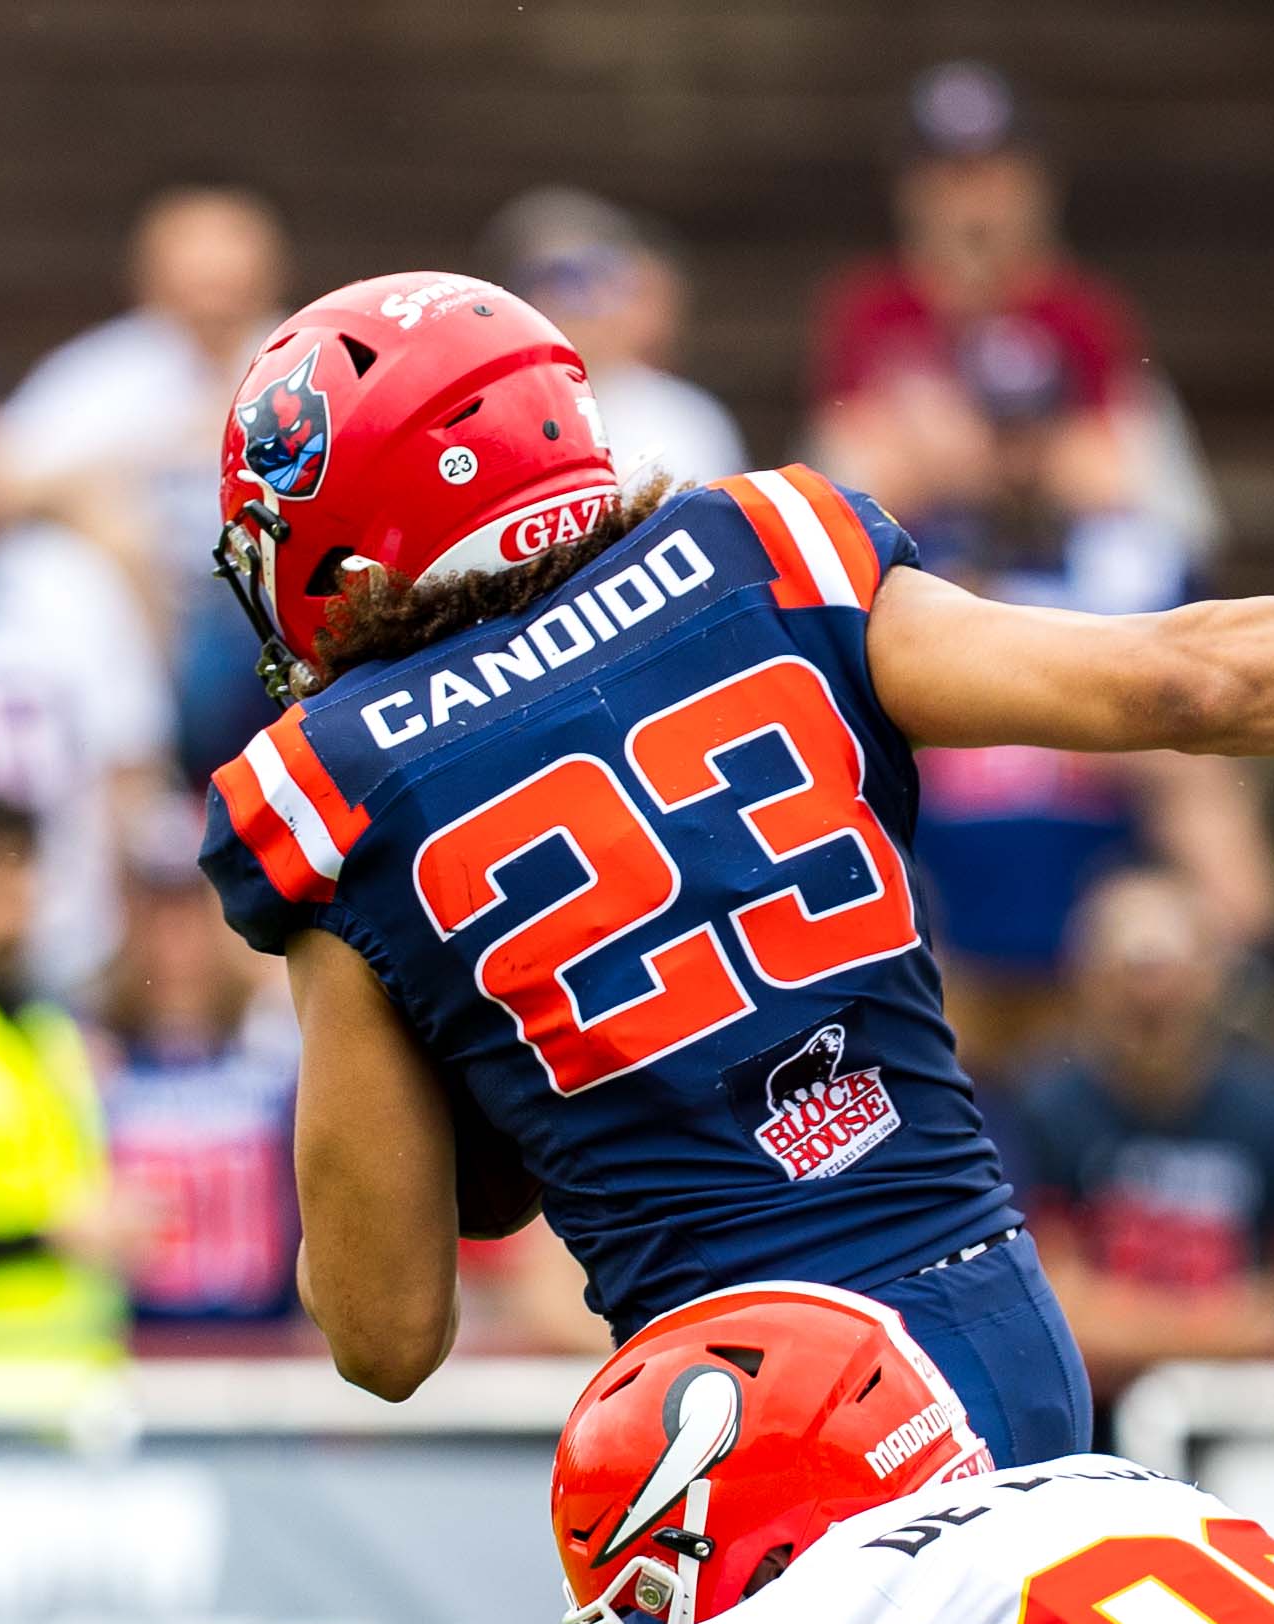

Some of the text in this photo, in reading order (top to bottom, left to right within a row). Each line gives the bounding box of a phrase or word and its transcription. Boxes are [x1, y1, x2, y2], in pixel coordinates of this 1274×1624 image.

[444, 453, 473, 478] 23
[359, 527, 715, 750] CANDIDO
[412, 655, 921, 1098] 23
[760, 1072, 877, 1155] BLOCK
[781, 1089, 890, 1181] HOUSE
[864, 1402, 952, 1480] MADRID
